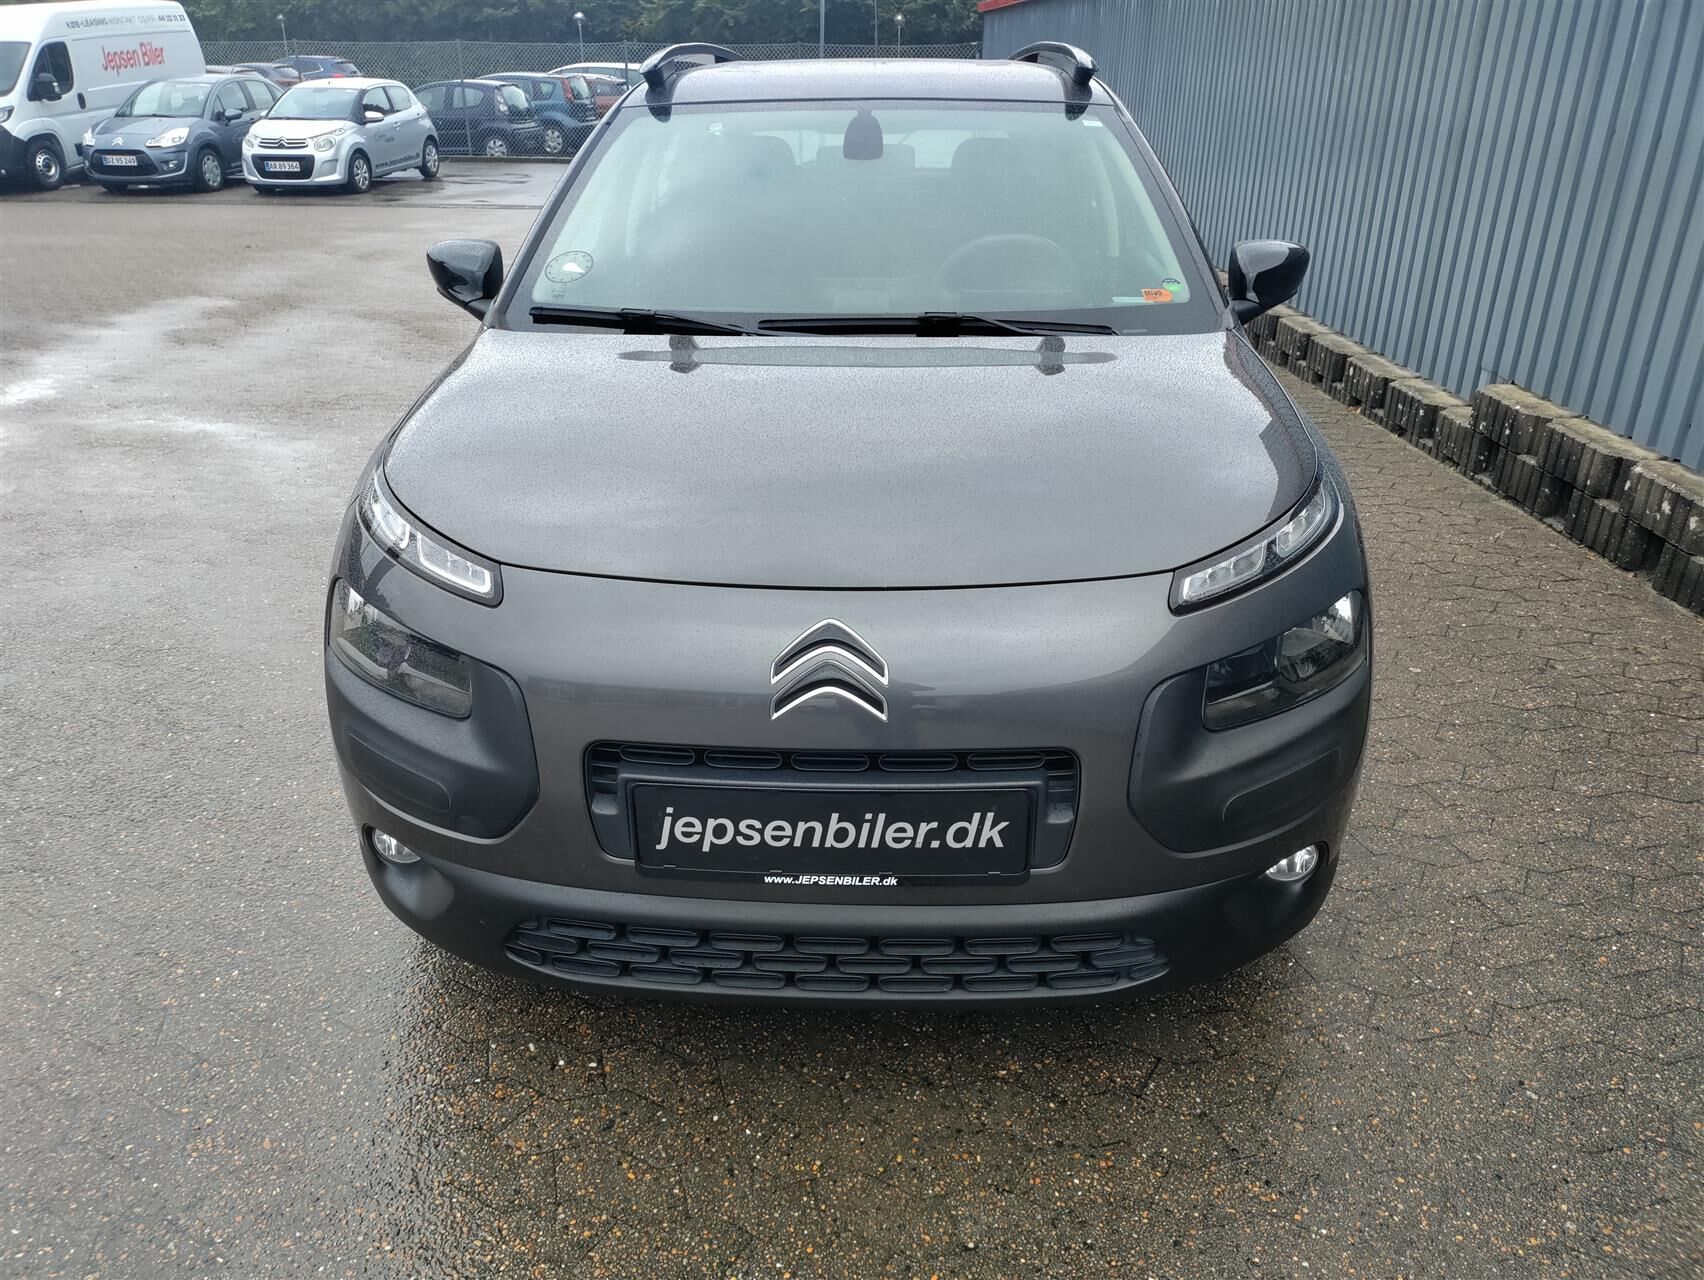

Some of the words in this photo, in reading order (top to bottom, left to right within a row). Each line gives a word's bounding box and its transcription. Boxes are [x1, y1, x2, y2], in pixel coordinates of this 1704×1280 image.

[101, 45, 140, 77] Jepsen
[139, 41, 165, 67] Biler
[655, 806, 1010, 852] jepsenbiler.dk
[764, 875, 898, 886] www.JEPSENBILER.dk
